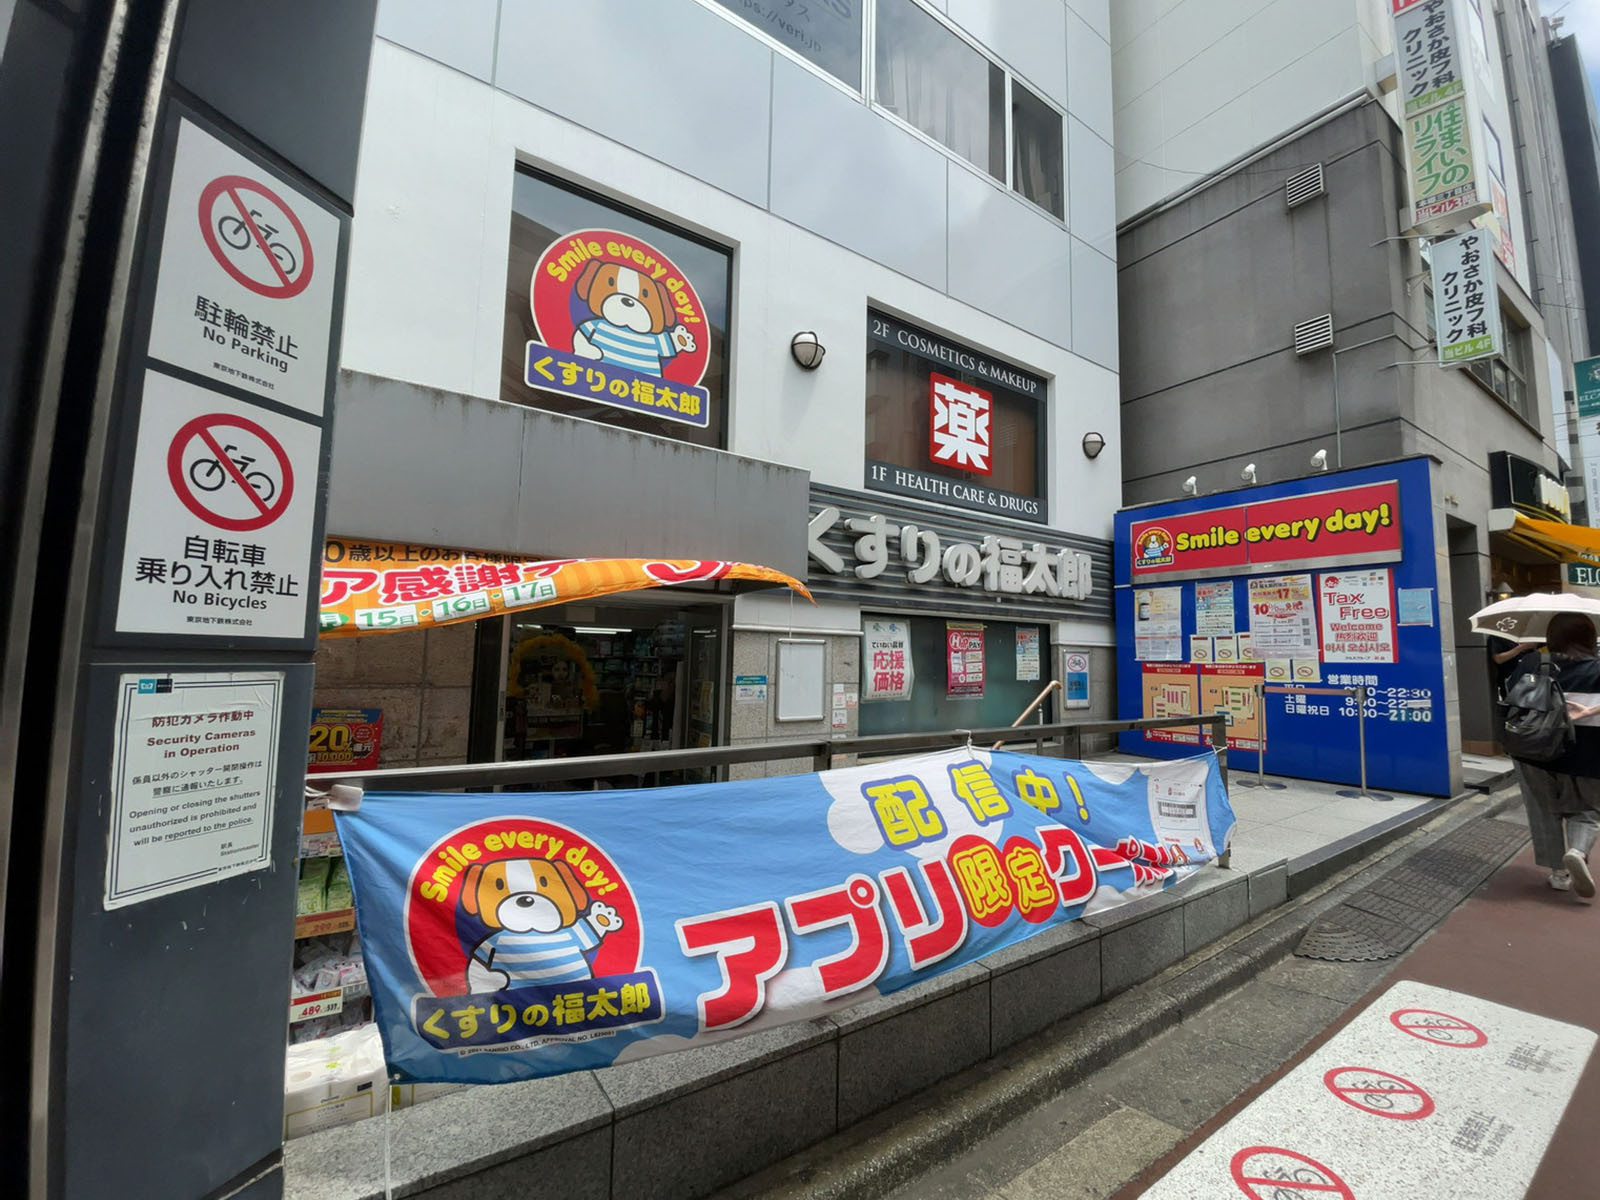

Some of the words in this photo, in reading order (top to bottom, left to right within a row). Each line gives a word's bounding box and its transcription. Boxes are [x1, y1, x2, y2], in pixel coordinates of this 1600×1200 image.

[1402, 27, 1429, 97] クリニック
[1414, 114, 1441, 196] リライフ
[1434, 101, 1470, 185] 住まいの
[546, 238, 604, 282] Smile
[606, 241, 668, 278] every
[665, 277, 701, 324] day!
[1459, 235, 1488, 339] やおさか皮フ科
[1441, 271, 1464, 344] クリニック
[194, 295, 298, 360] 駐輪禁止
[202, 325, 226, 345] No
[231, 337, 289, 373] Parking
[872, 319, 890, 338] 2F
[897, 329, 976, 371] COSMETICS
[978, 361, 988, 376] &
[990, 364, 1037, 394] MAKEUP
[1444, 344, 1474, 359] 当ビル
[1476, 338, 1492, 350] 4F
[533, 356, 701, 416] くすりの福太郎
[934, 381, 990, 471] 薬
[871, 465, 887, 482] 1F
[895, 470, 950, 496] HEALTH
[952, 484, 985, 505] CARE
[987, 493, 997, 506] &
[1000, 495, 1039, 515] DRUGS
[1175, 525, 1240, 552] Smile
[1245, 517, 1322, 542] every
[1324, 502, 1391, 535] day!
[184, 534, 267, 567] 自転車
[808, 506, 1092, 600] くすりの福太郎
[135, 557, 299, 597] 乗り入れ禁止
[173, 590, 198, 604] No
[204, 593, 267, 610] Bicycles
[1323, 592, 1365, 605] Tax
[1339, 606, 1389, 620] Free
[186, 616, 253, 627] 東京地下鉄株式会社
[1330, 622, 1384, 631] Welcome
[873, 650, 905, 671] 応援
[873, 671, 905, 692] 価格
[1327, 674, 1378, 686] 営業時間
[1284, 694, 1307, 705] 土曜
[1285, 704, 1330, 716] 日曜祝日
[152, 710, 254, 728] 防犯カメラ作動中
[147, 733, 201, 747] Security
[205, 729, 256, 741] Cameras
[164, 750, 176, 759] in
[180, 743, 240, 758] Operation
[132, 760, 263, 785] 係員以外のシャッター開閉操作は
[129, 804, 168, 820] Opening
[170, 804, 180, 812] or
[182, 798, 213, 812] closing
[214, 795, 228, 804] the
[229, 790, 261, 802] shutters
[129, 815, 188, 833] unauthorized
[200, 805, 242, 821] prohibited
[242, 802, 257, 812] and
[861, 758, 1091, 851] 配信中!
[133, 836, 150, 847] will
[151, 834, 163, 843] be
[165, 826, 202, 842] reported
[203, 825, 212, 833] to
[213, 821, 227, 831] the
[228, 815, 254, 829] police.
[420, 842, 483, 902] Smile
[484, 830, 564, 859] every
[565, 846, 619, 895] day!
[422, 982, 652, 1039] くすりの福太郎
